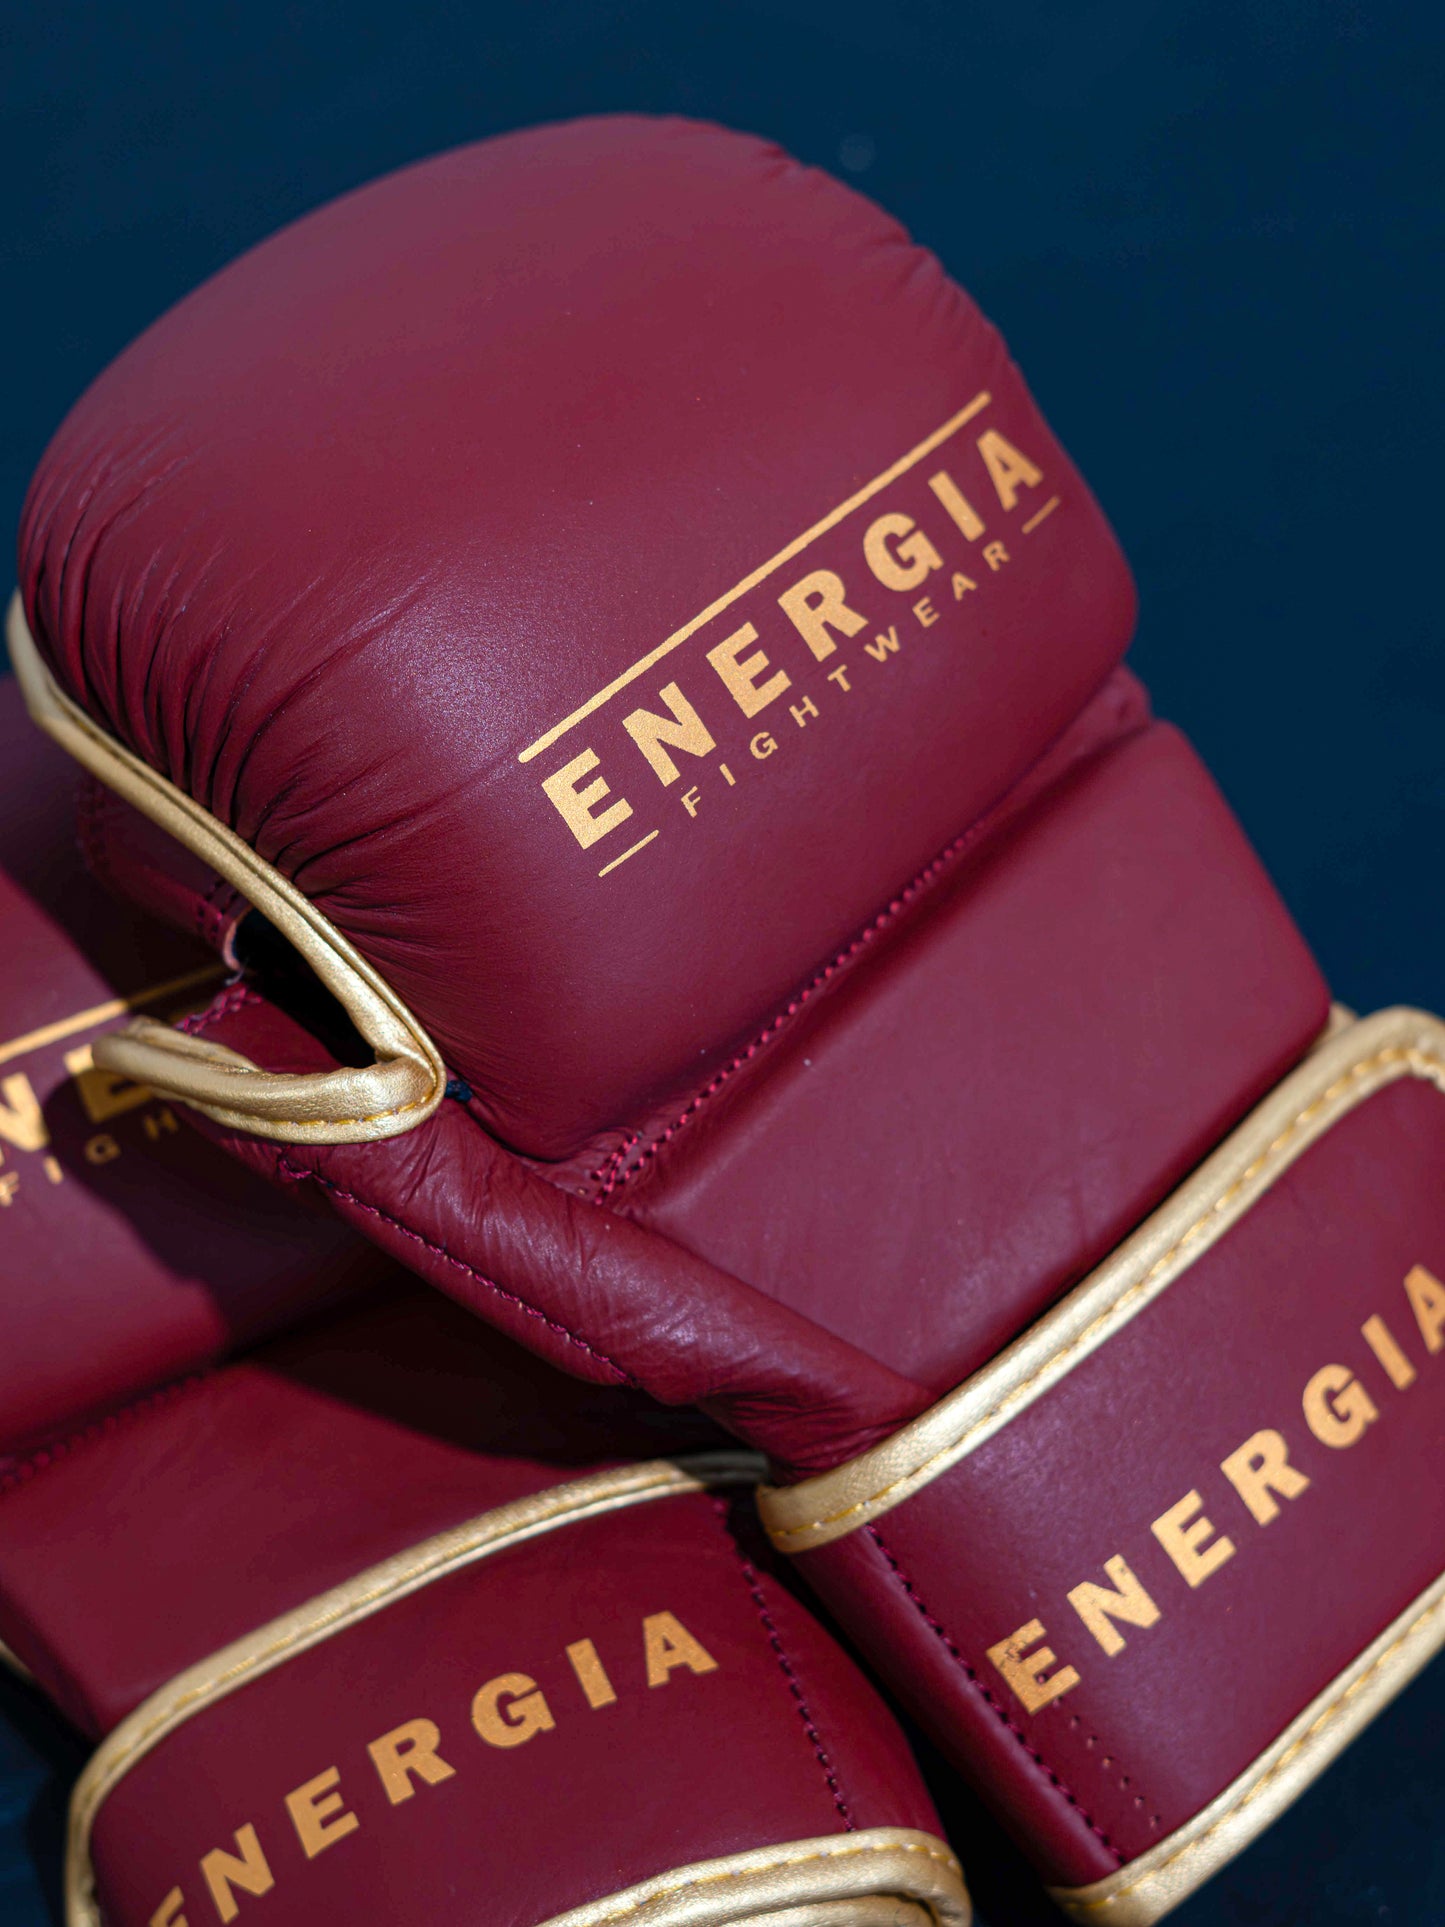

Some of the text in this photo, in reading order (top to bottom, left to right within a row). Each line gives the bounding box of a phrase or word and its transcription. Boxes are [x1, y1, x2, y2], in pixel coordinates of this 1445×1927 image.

[541, 429, 1043, 850] ENERGIA
[680, 541, 1010, 818] FIGHTWEAR
[986, 1264, 1445, 1716] ENERGIA
